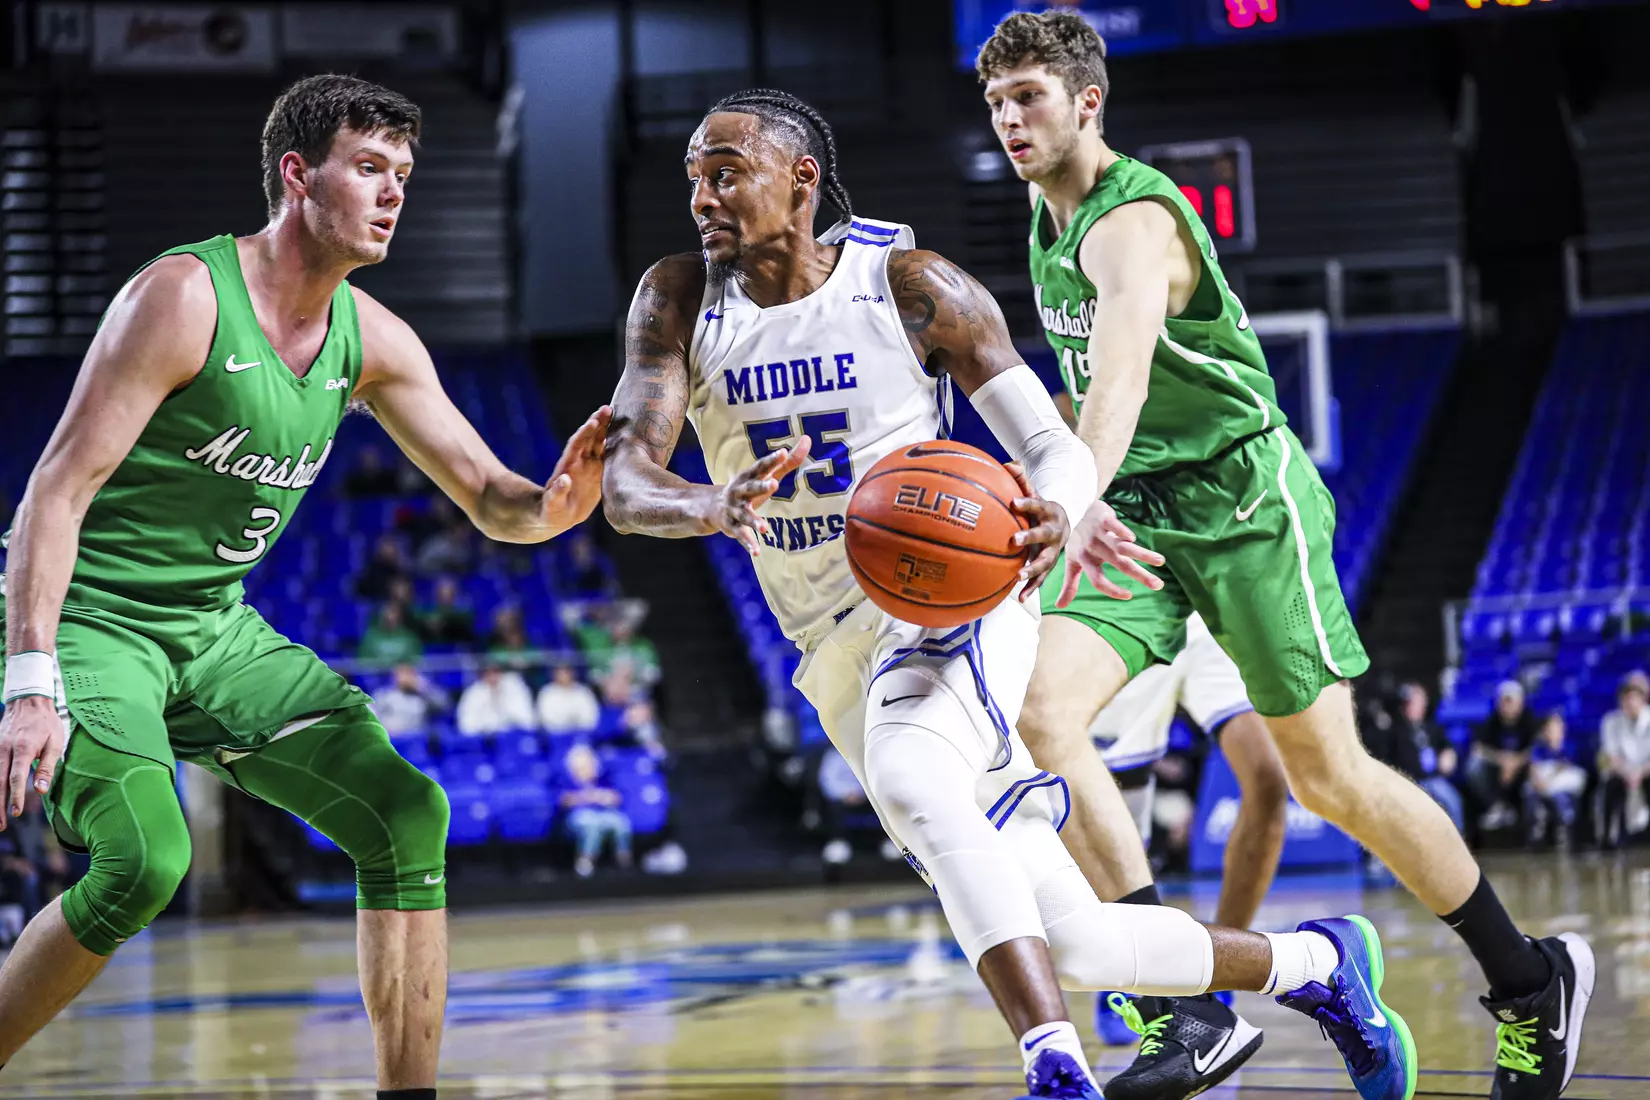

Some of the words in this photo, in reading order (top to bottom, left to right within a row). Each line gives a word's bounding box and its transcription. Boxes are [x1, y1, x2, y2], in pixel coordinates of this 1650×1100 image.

[723, 352, 858, 405] MIDDLE
[184, 423, 335, 490] Marshal
[742, 407, 857, 503] 55
[892, 505, 976, 532] CHAMPIONSHIP
[894, 484, 983, 528] ELITE
[213, 506, 282, 564] 3
